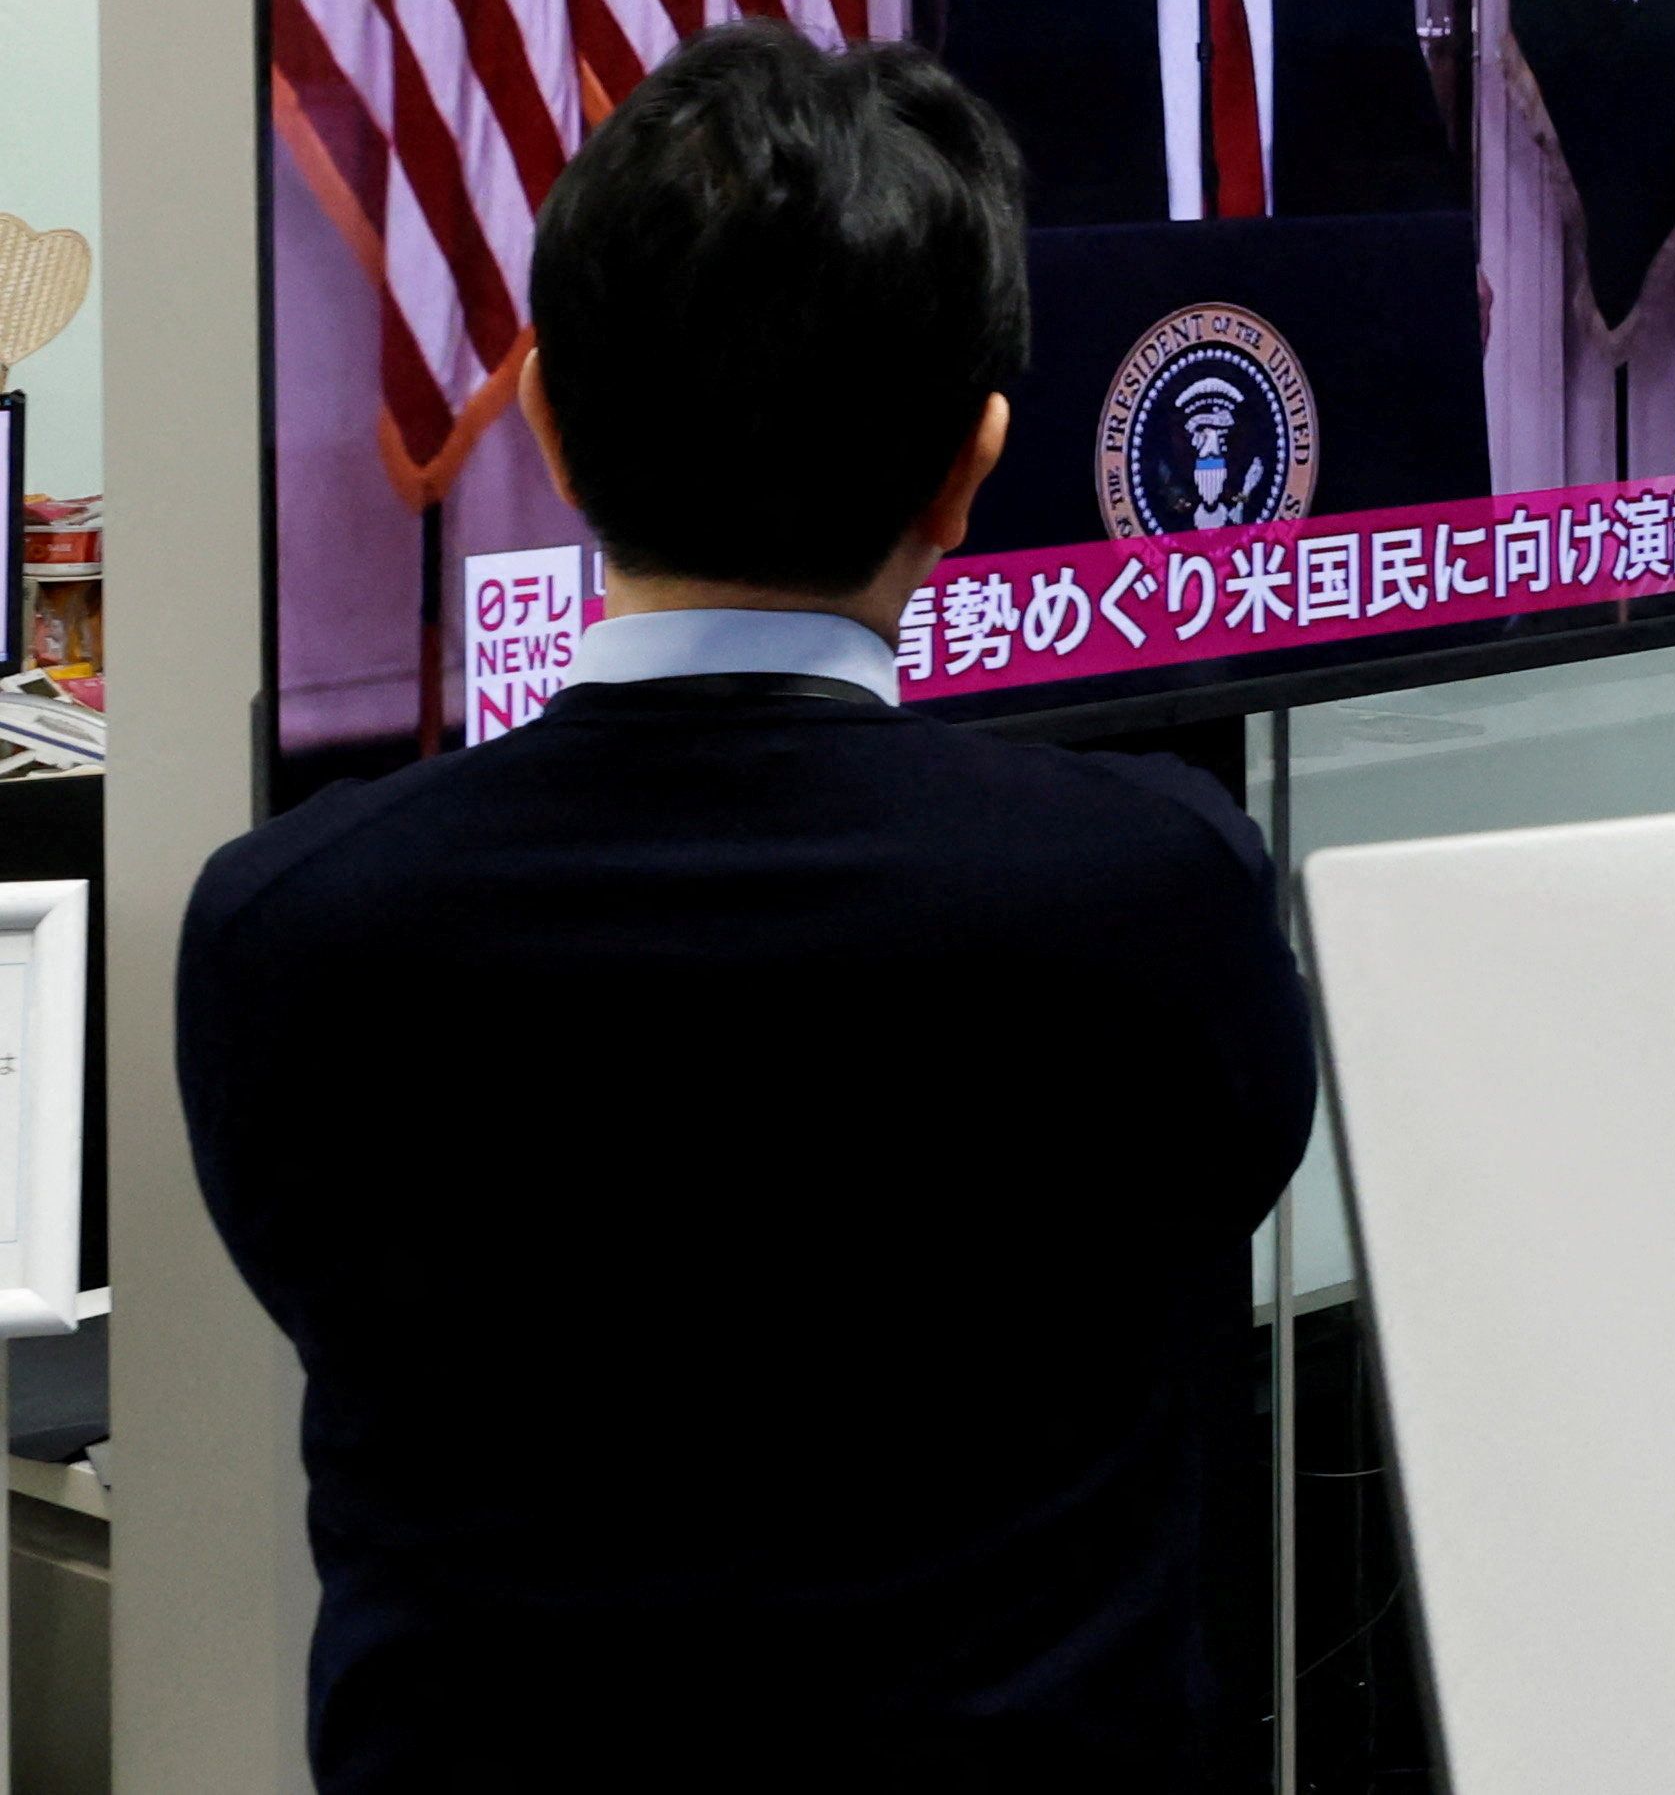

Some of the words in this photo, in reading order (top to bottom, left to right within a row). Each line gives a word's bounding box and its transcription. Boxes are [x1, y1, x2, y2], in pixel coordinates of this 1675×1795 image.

[1106, 313, 1204, 454] PRESIDENT
[1267, 344, 1310, 466] UNITED
[476, 631, 573, 678] NEWS
